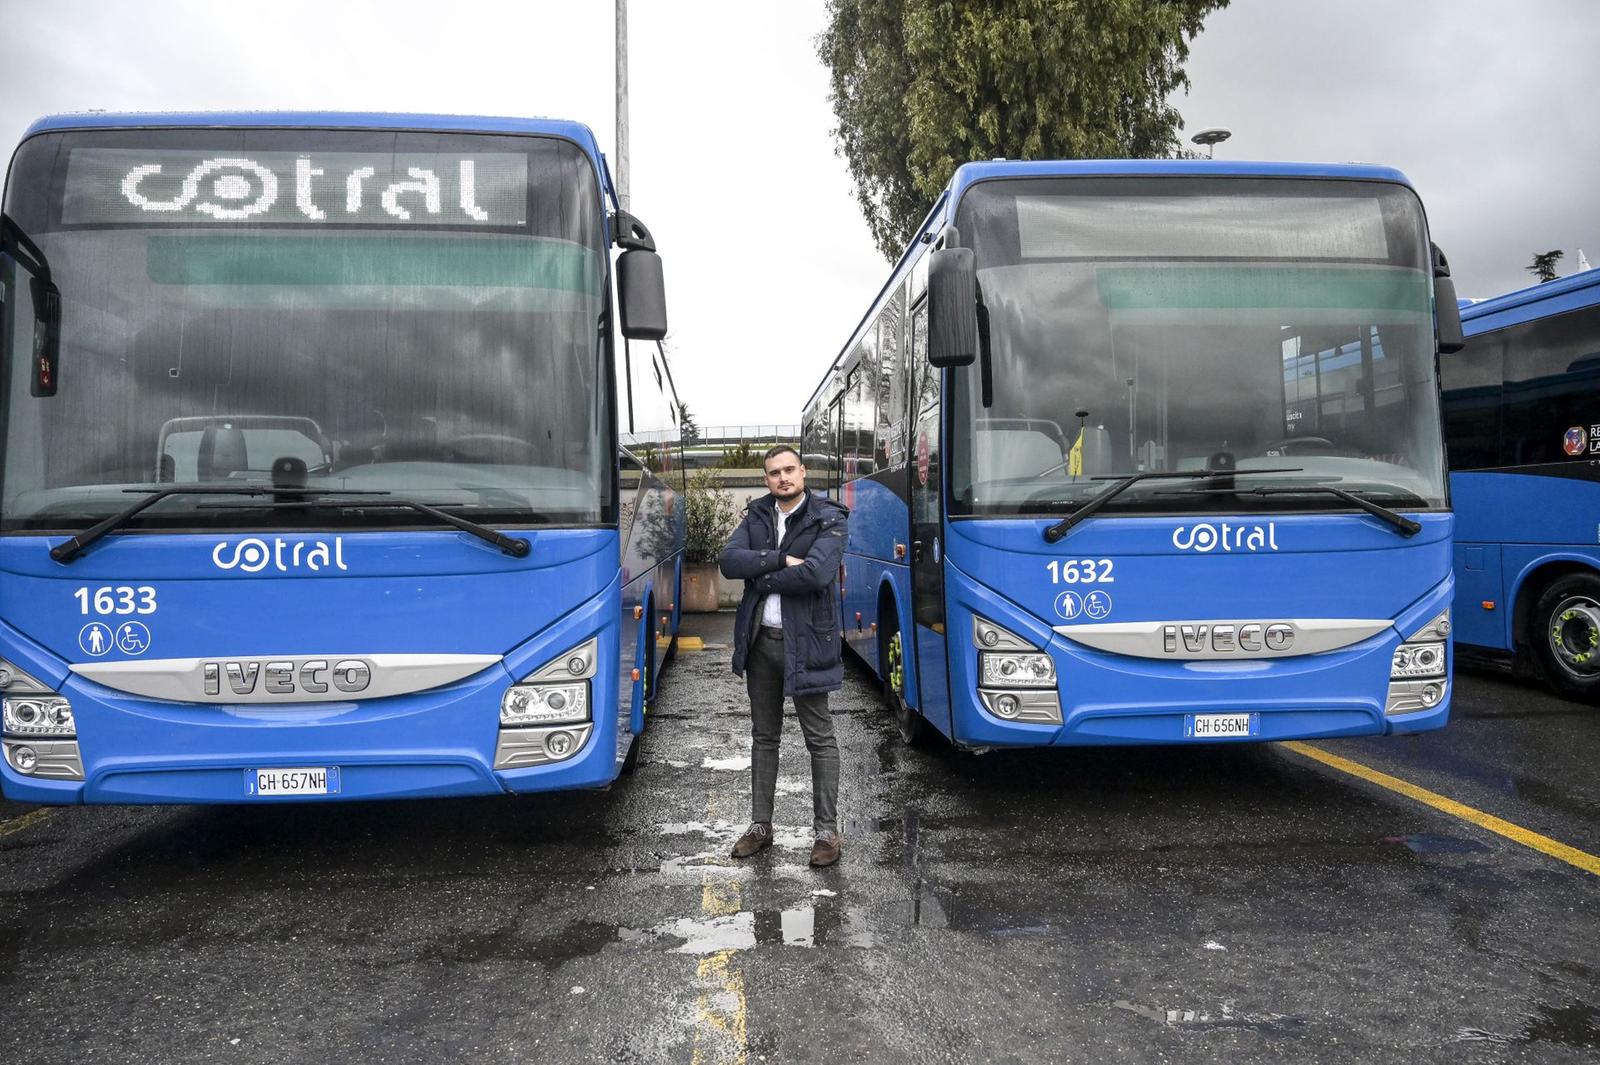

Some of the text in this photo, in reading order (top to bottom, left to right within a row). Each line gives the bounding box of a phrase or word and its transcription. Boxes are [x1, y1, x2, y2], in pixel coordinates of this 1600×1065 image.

[121, 155, 488, 220] cotral
[1172, 522, 1279, 552] cotral
[212, 536, 348, 572] cotral
[1046, 558, 1115, 584] 1632
[73, 586, 157, 615] 1633
[1163, 623, 1295, 653] IVECO
[204, 659, 371, 696] IVECO
